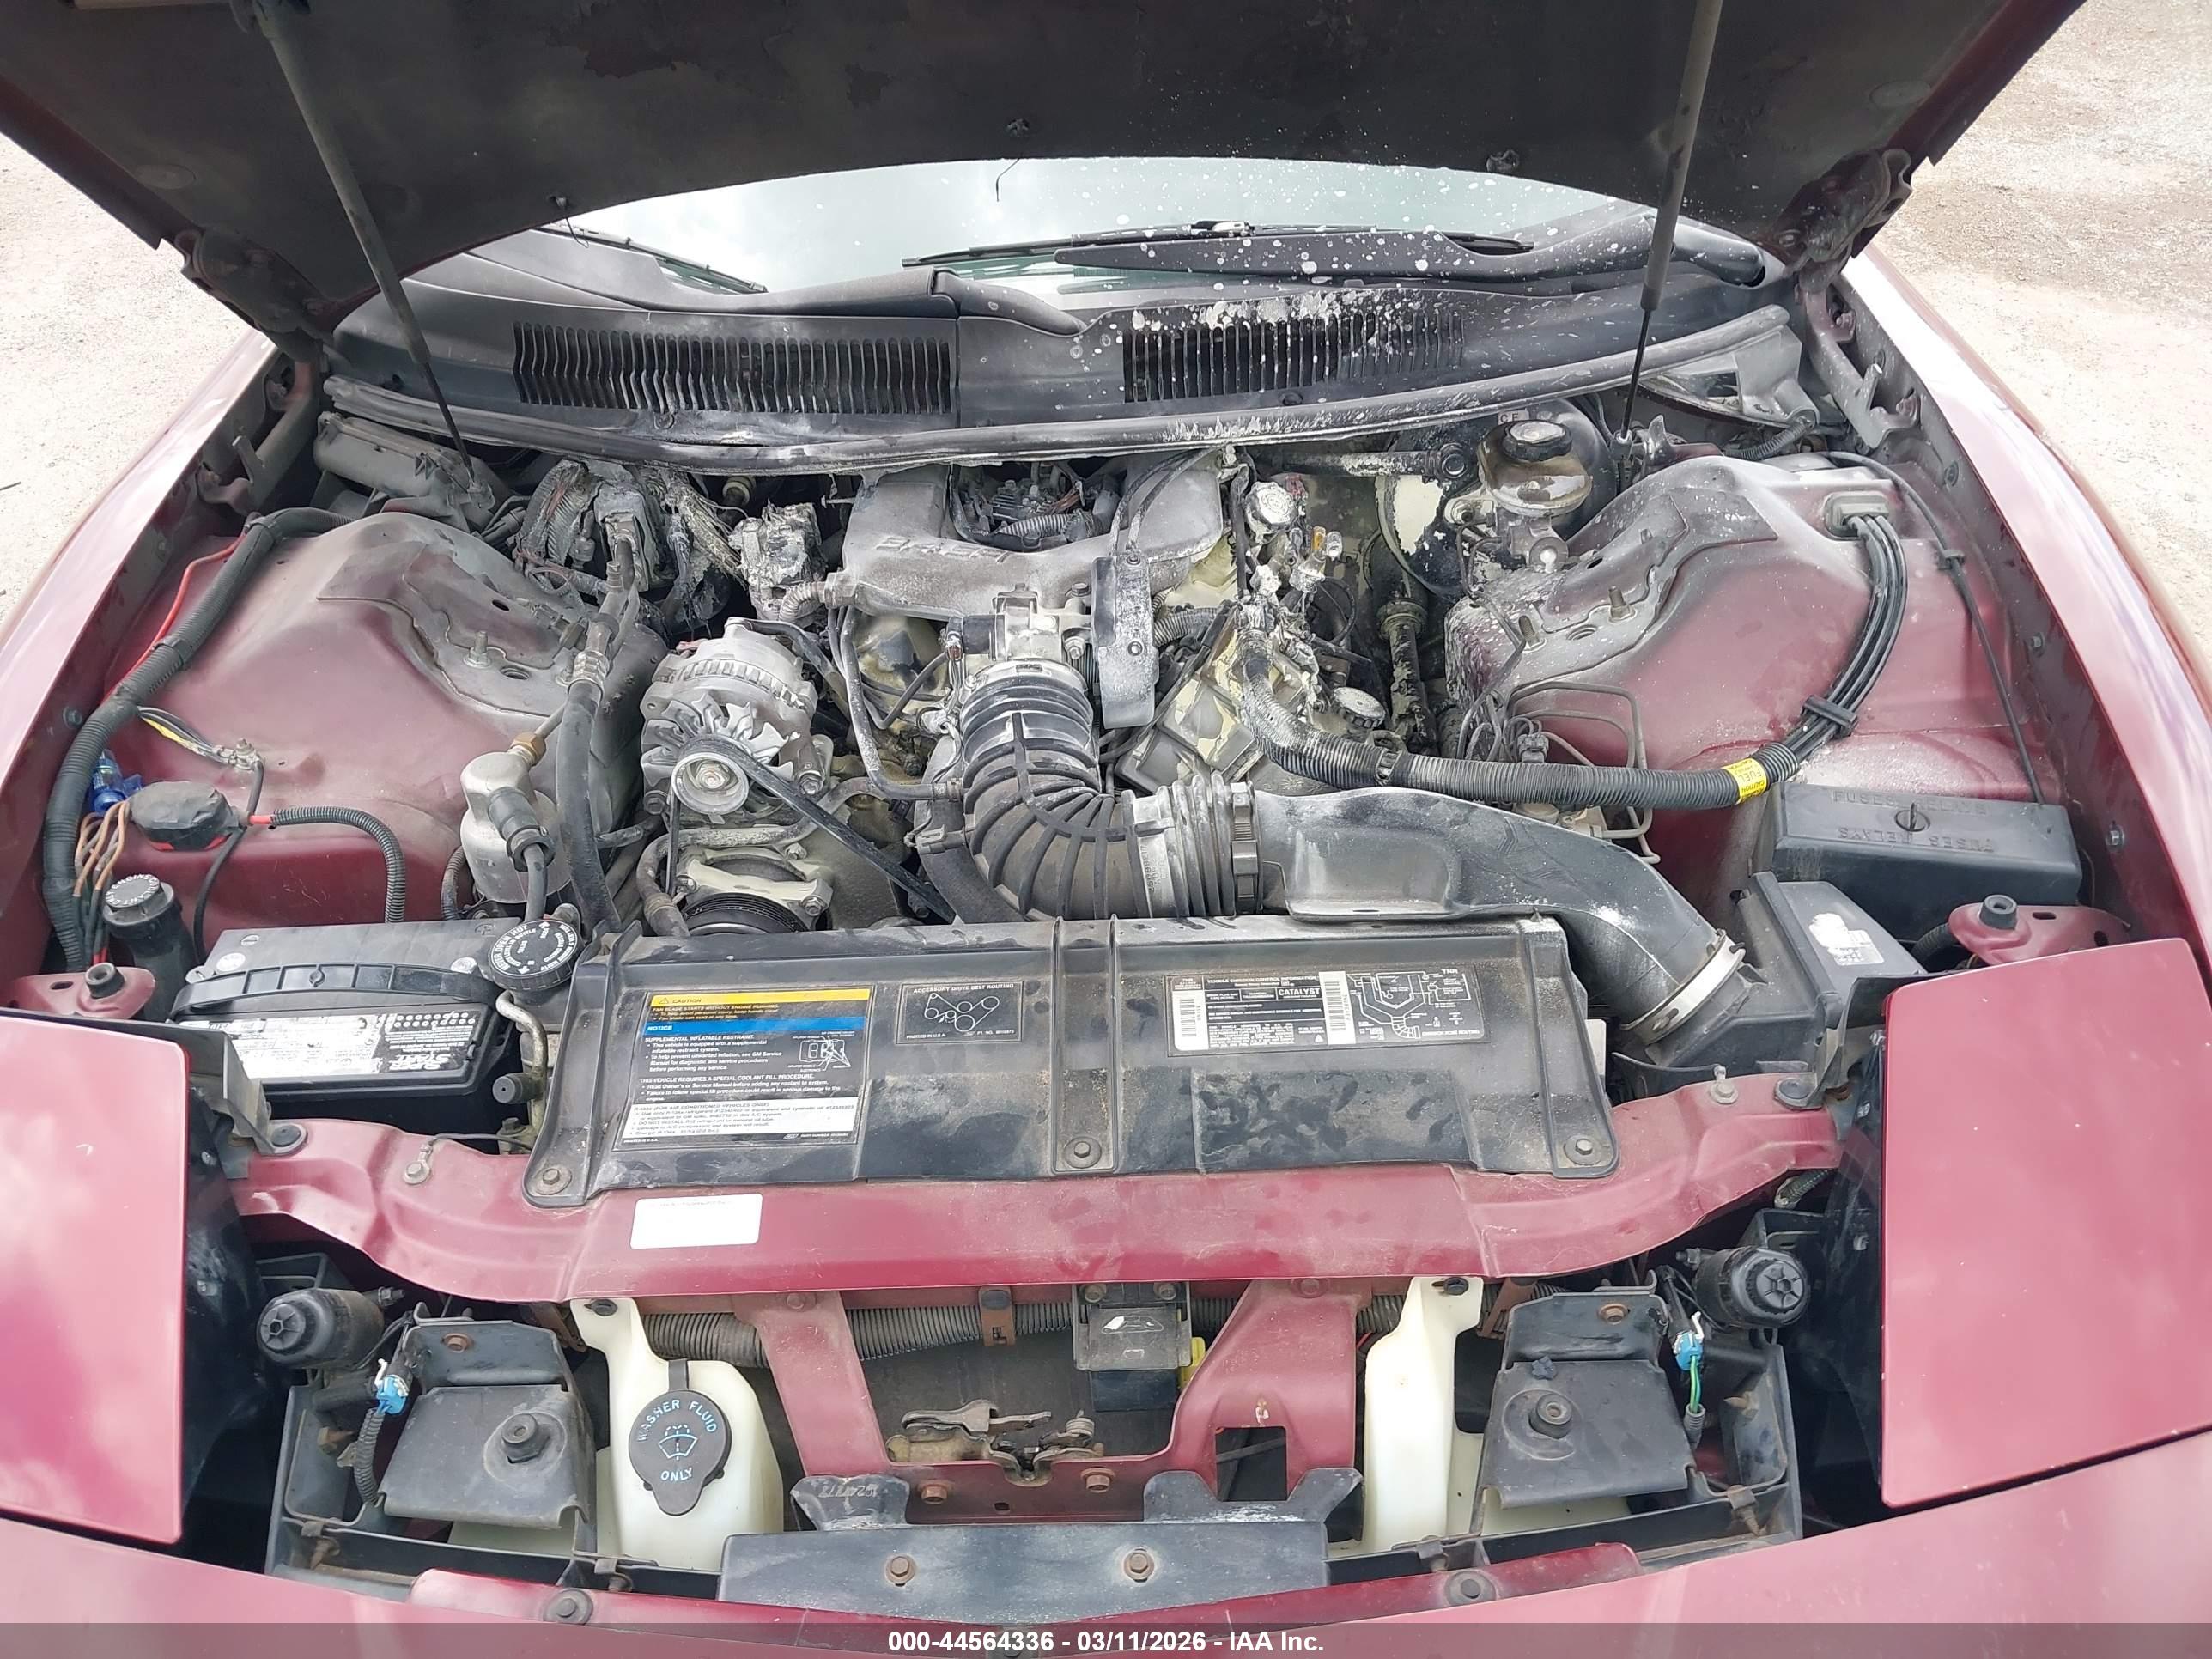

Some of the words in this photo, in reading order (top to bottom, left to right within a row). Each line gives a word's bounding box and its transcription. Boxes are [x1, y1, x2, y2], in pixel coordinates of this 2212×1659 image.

[1741, 781, 1765, 793] CAUTION
[1832, 789, 1896, 806] FUSES
[111, 873, 151, 890] ENGINE
[495, 935, 513, 952] OPEN
[510, 924, 528, 936] HOT
[1278, 988, 1321, 996] CATALYST
[389, 1060, 441, 1070] SUPER
[636, 1399, 681, 1443] WASHER
[689, 1401, 718, 1433] FLUID
[660, 1467, 693, 1482] ONLY
